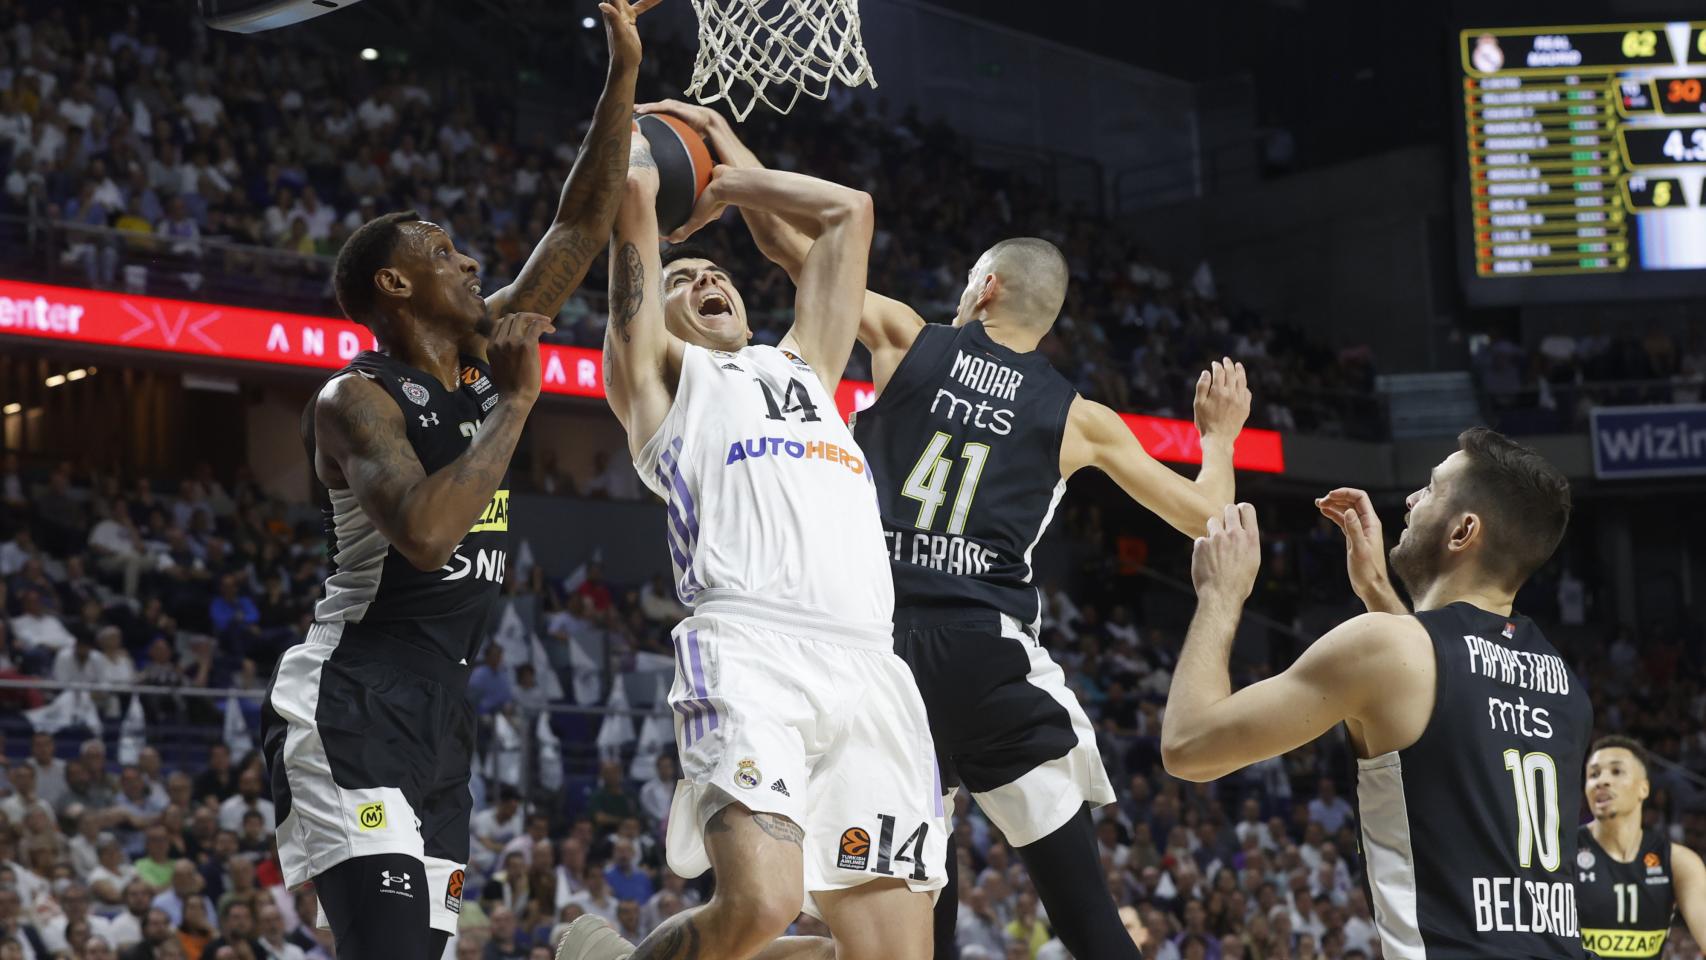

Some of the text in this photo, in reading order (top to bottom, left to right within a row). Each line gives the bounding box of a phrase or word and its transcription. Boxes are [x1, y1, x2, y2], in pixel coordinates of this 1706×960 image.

[1622, 30, 1658, 58] 62
[1667, 79, 1702, 103] 30
[753, 376, 821, 422] 14
[949, 349, 1023, 401] MADAR
[930, 388, 1015, 436] mts
[901, 430, 991, 536] 41
[1463, 635, 1569, 695] PAPAPETROU
[1488, 696, 1553, 739] mts
[1503, 748, 1560, 872] 10
[870, 813, 929, 881] 14
[1613, 883, 1638, 924] 11
